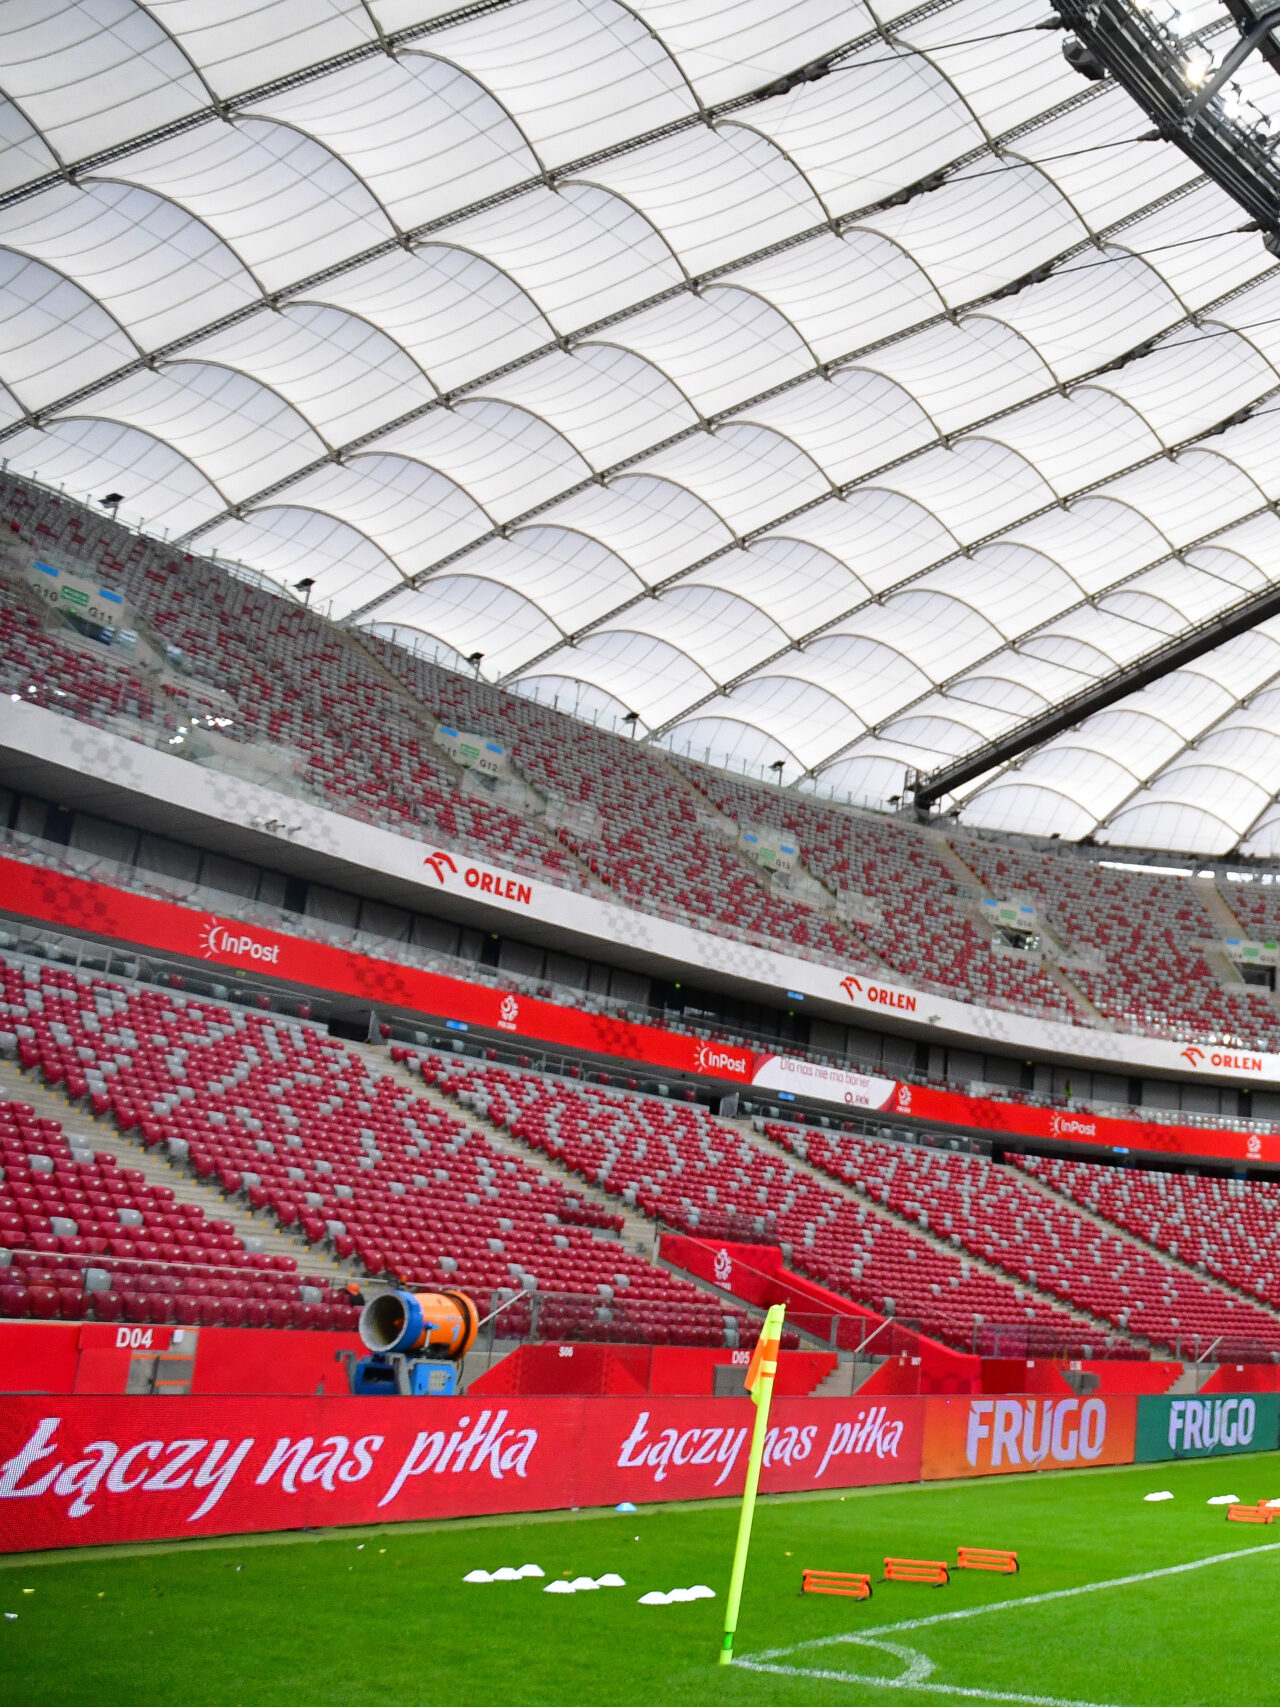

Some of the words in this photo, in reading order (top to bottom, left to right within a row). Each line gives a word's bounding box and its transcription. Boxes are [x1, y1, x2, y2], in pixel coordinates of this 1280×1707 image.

[464, 867, 533, 905] ORLEN
[221, 930, 280, 965] InPost
[867, 986, 916, 1012] ORLEN
[708, 1050, 747, 1074] InPost
[1210, 1053, 1262, 1071] ORLEN
[1061, 1119, 1096, 1137] InPost
[116, 1327, 154, 1349] D04
[732, 1350, 750, 1364] D05
[966, 1397, 1107, 1466] FRUGO
[1168, 1397, 1256, 1451] FRUGO
[616, 1411, 748, 1487] Łączy
[814, 1406, 904, 1478] piłka
[1, 1417, 254, 1522] Łączy
[255, 1435, 385, 1493] nas
[377, 1409, 538, 1508] piłka
